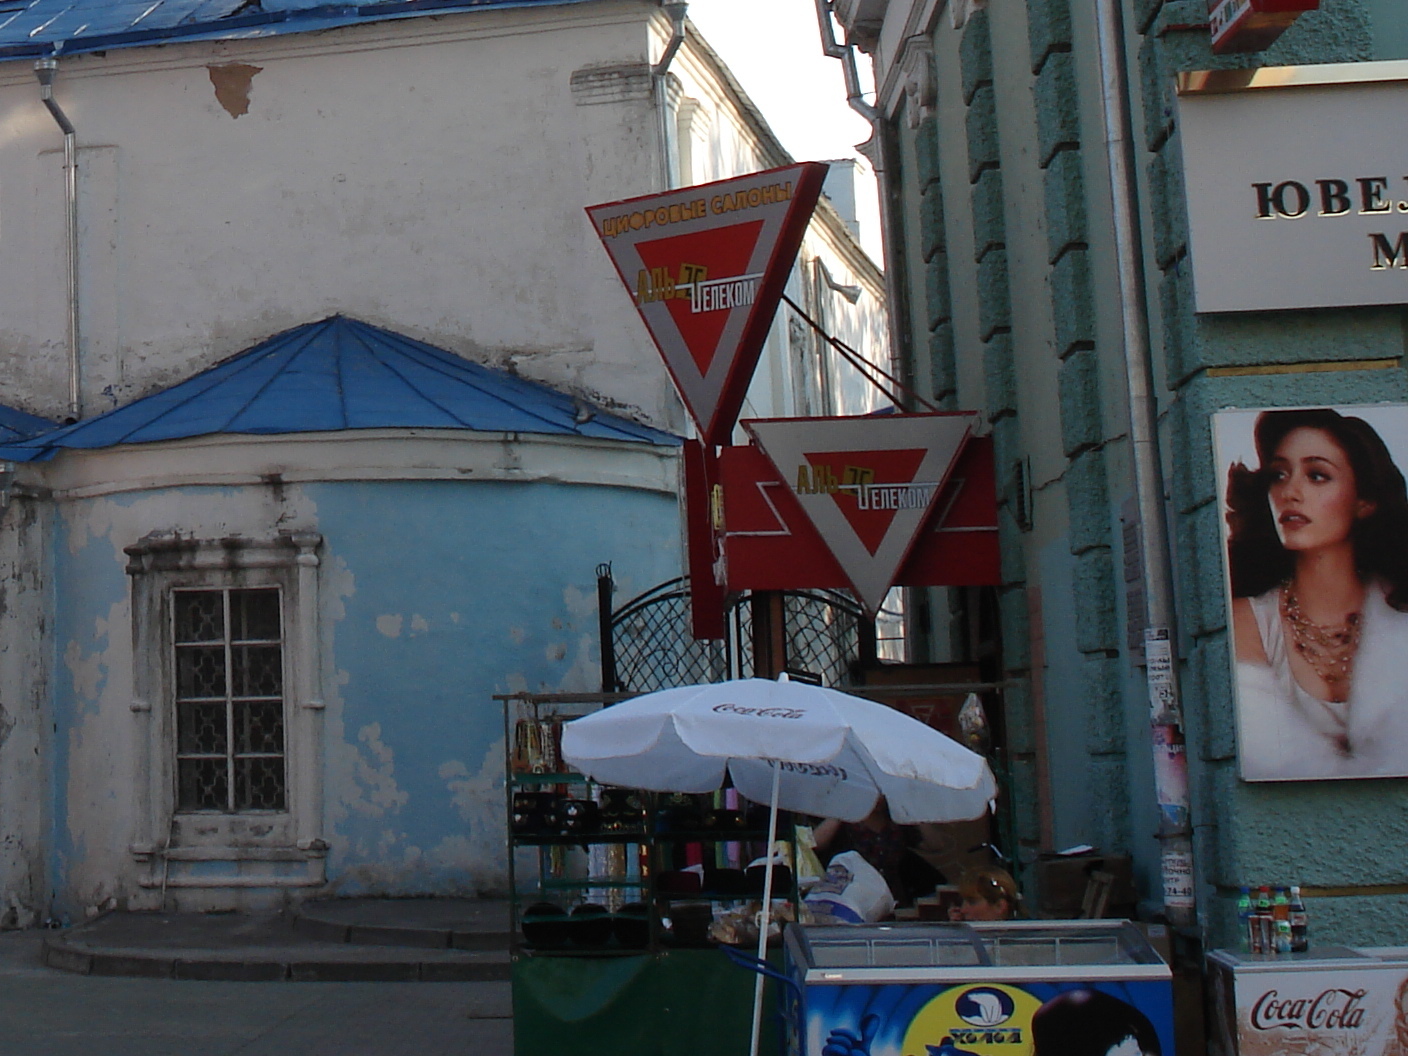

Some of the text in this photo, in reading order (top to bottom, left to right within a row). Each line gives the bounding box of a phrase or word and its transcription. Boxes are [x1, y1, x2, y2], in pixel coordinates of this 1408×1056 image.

[602, 181, 792, 238] ЦИФРОВЫЕ САЛОНЫ
[712, 703, 808, 719] Coca-Cola
[1250, 988, 1368, 1030] Coca-Cola
